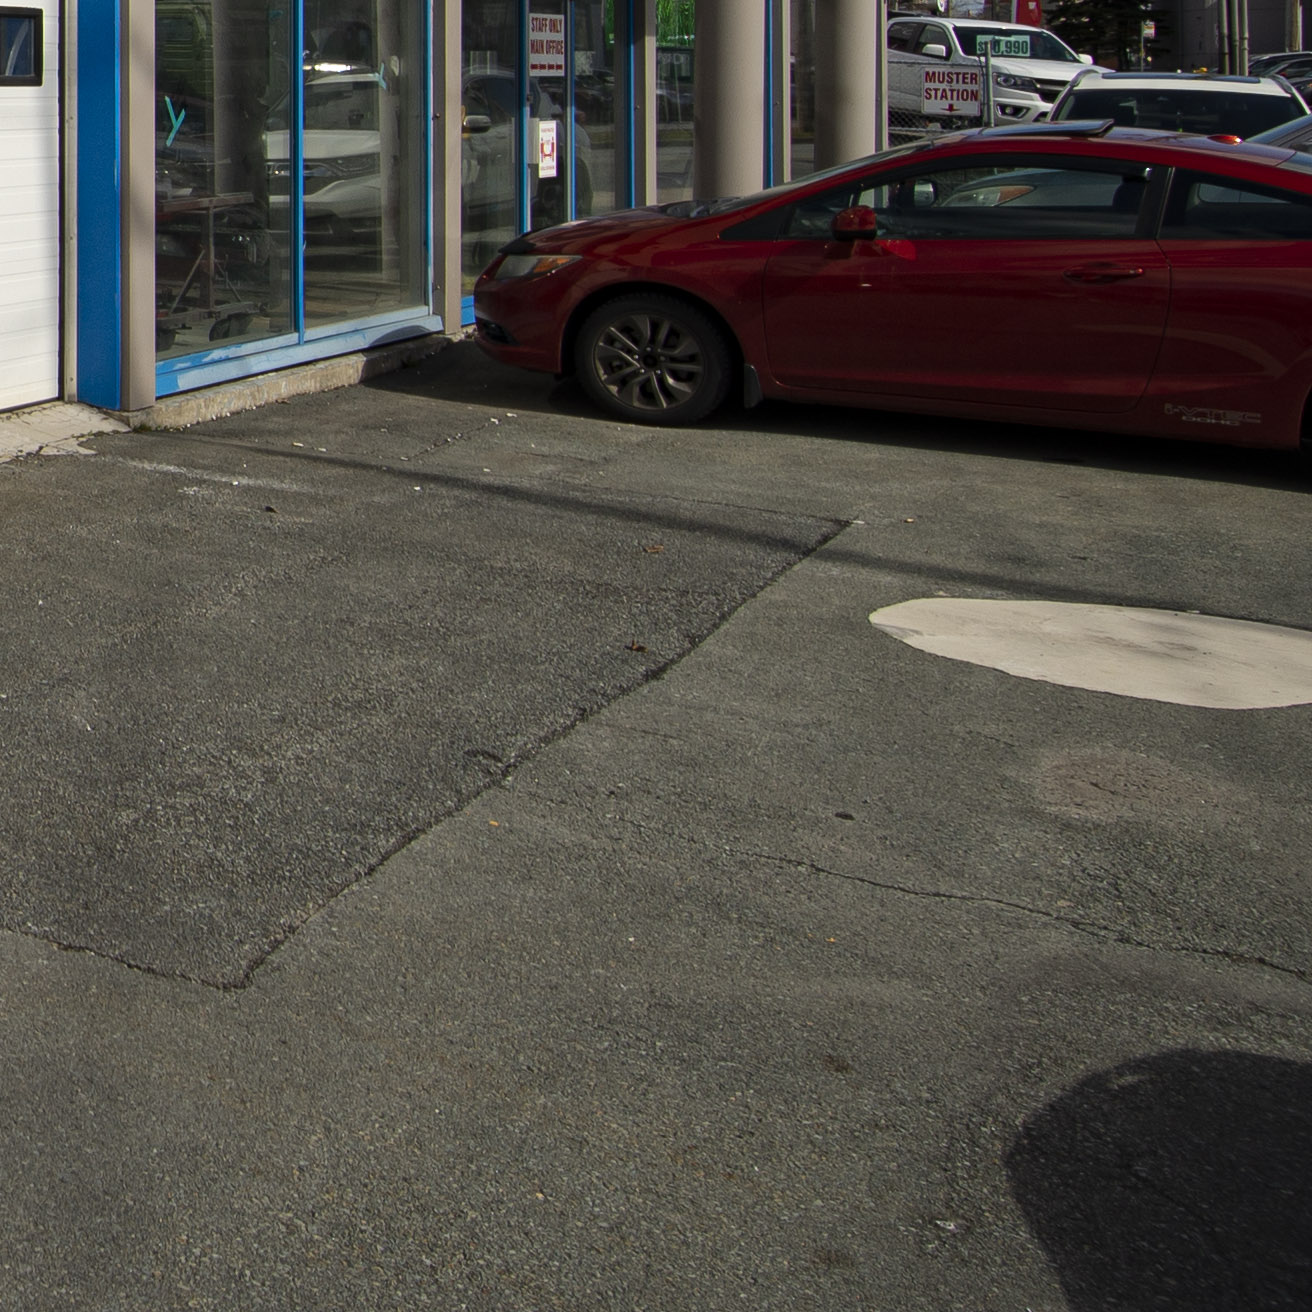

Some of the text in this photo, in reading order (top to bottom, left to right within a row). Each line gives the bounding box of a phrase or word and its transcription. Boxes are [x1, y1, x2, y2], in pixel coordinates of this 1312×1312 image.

[530, 16, 563, 34] STAFF ONLY
[530, 39, 564, 55] MAIN OFFICE
[978, 39, 1029, 56] $0,990
[924, 71, 979, 86] MUSTER
[923, 88, 979, 102] STATION
